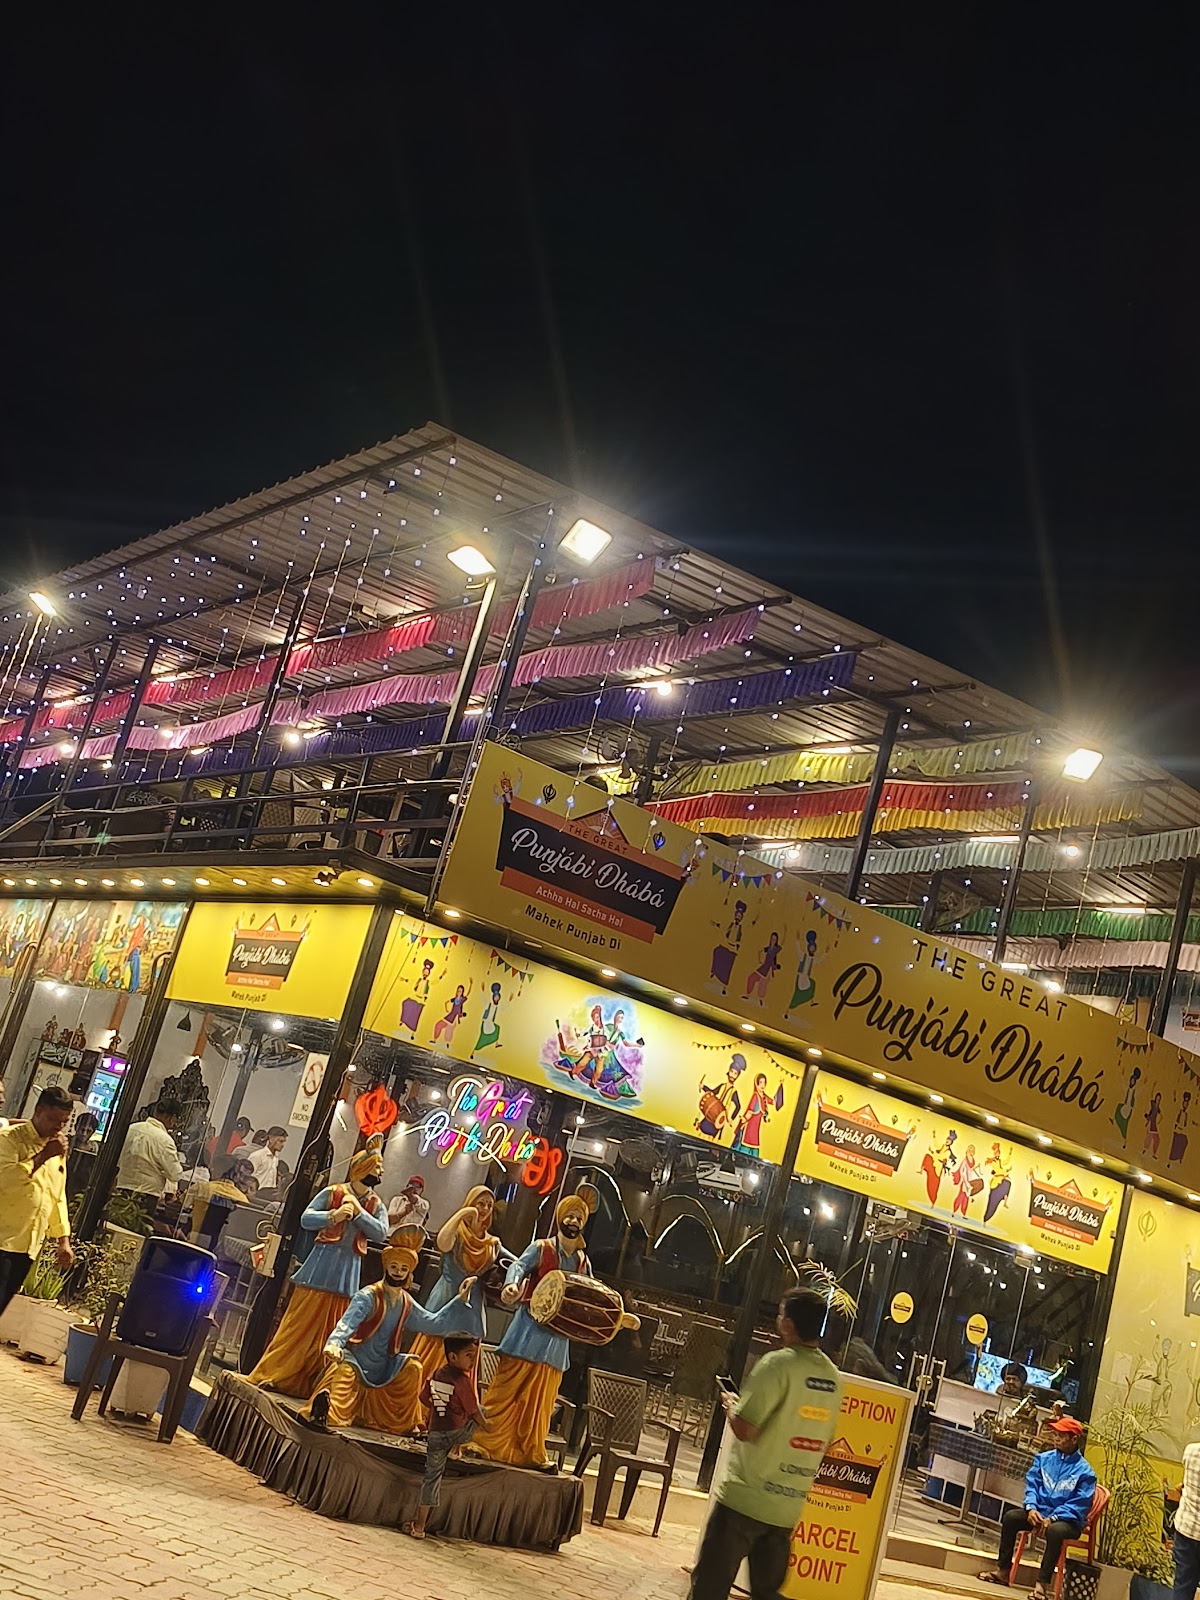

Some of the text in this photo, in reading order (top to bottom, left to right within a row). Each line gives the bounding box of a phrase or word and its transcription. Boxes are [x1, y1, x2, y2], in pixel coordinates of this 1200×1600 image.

[569, 824, 628, 855] THE GREAT
[525, 905, 621, 949] Mahek Punjab Di
[915, 941, 1070, 1022] THE GREAT
[839, 1396, 896, 1425] EPTION
[790, 1520, 860, 1554] ARCEL
